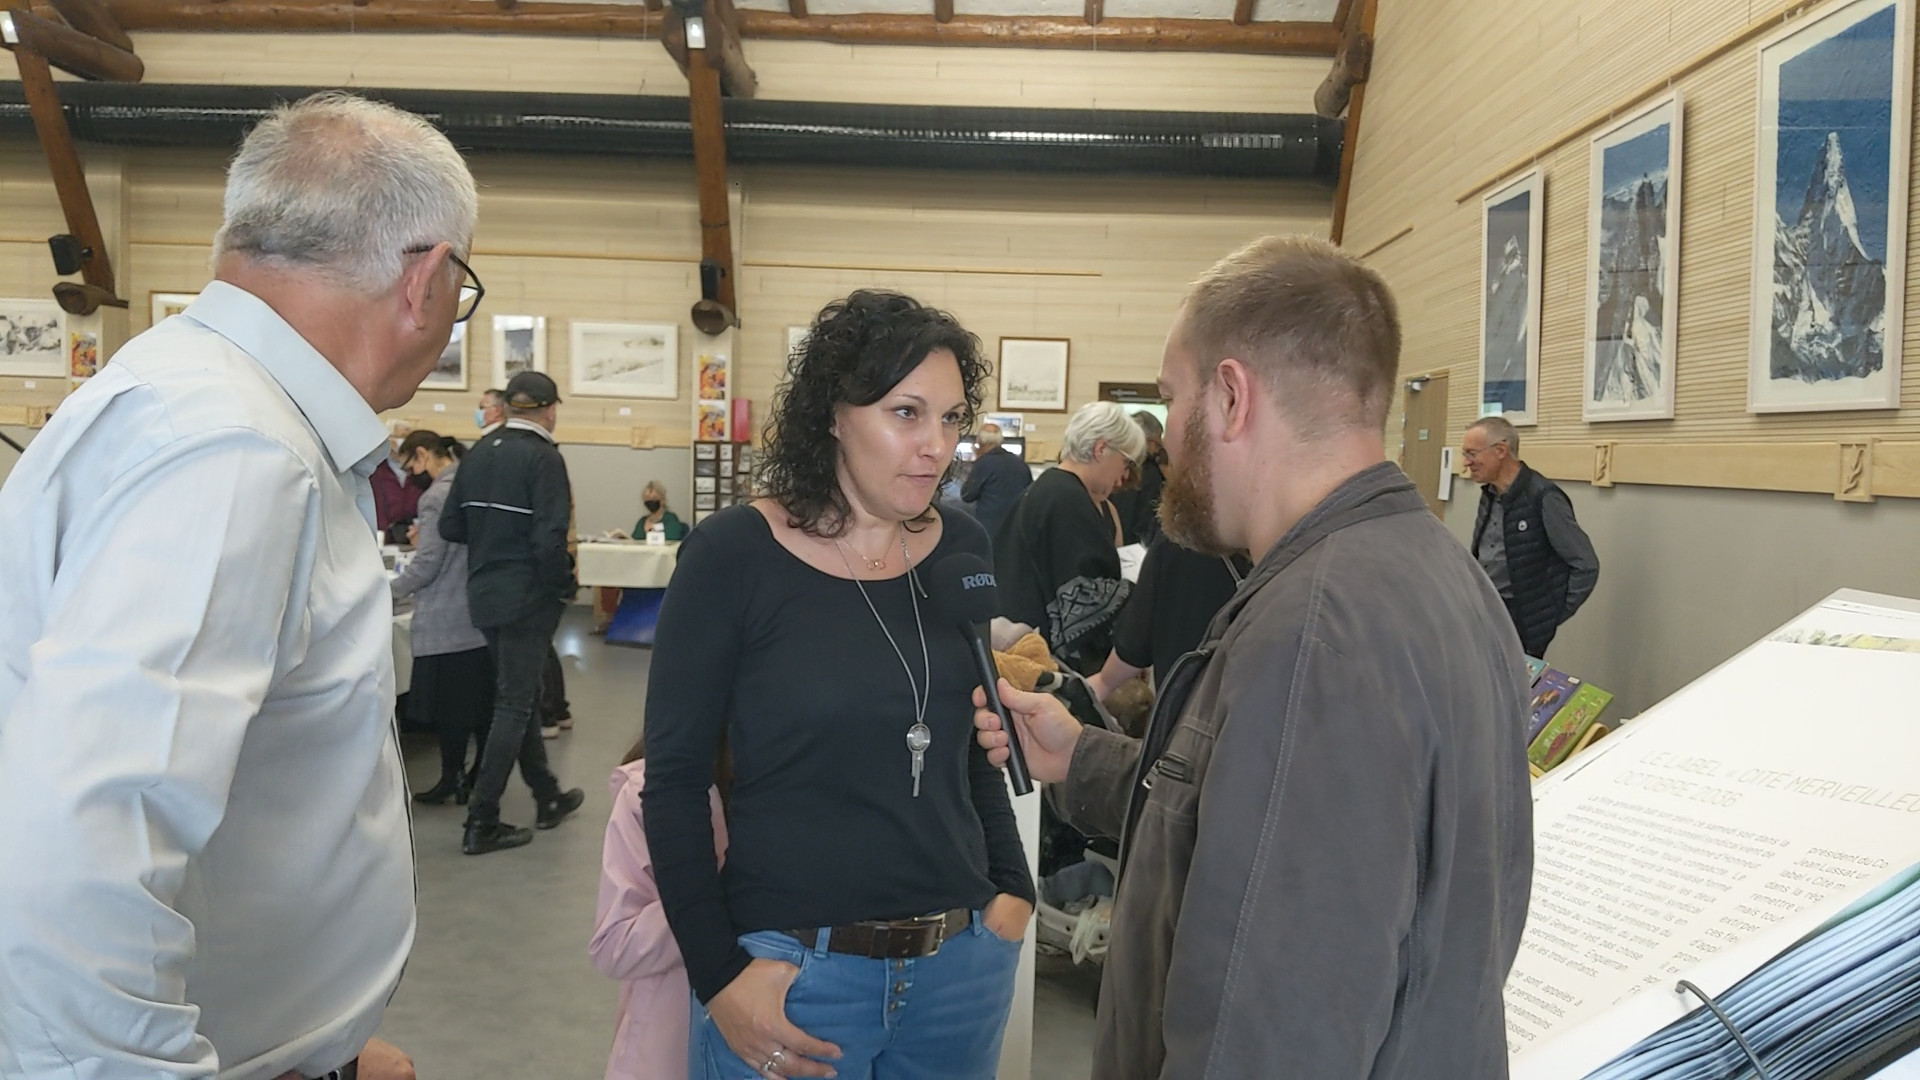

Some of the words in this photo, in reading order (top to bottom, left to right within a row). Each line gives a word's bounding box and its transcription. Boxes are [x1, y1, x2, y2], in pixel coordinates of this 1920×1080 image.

[1613, 769, 1698, 797] OCTOBRE
[1689, 785, 1744, 807] 2036
[1663, 755, 1723, 777] LABEL
[1738, 767, 1795, 790] CITÉ
